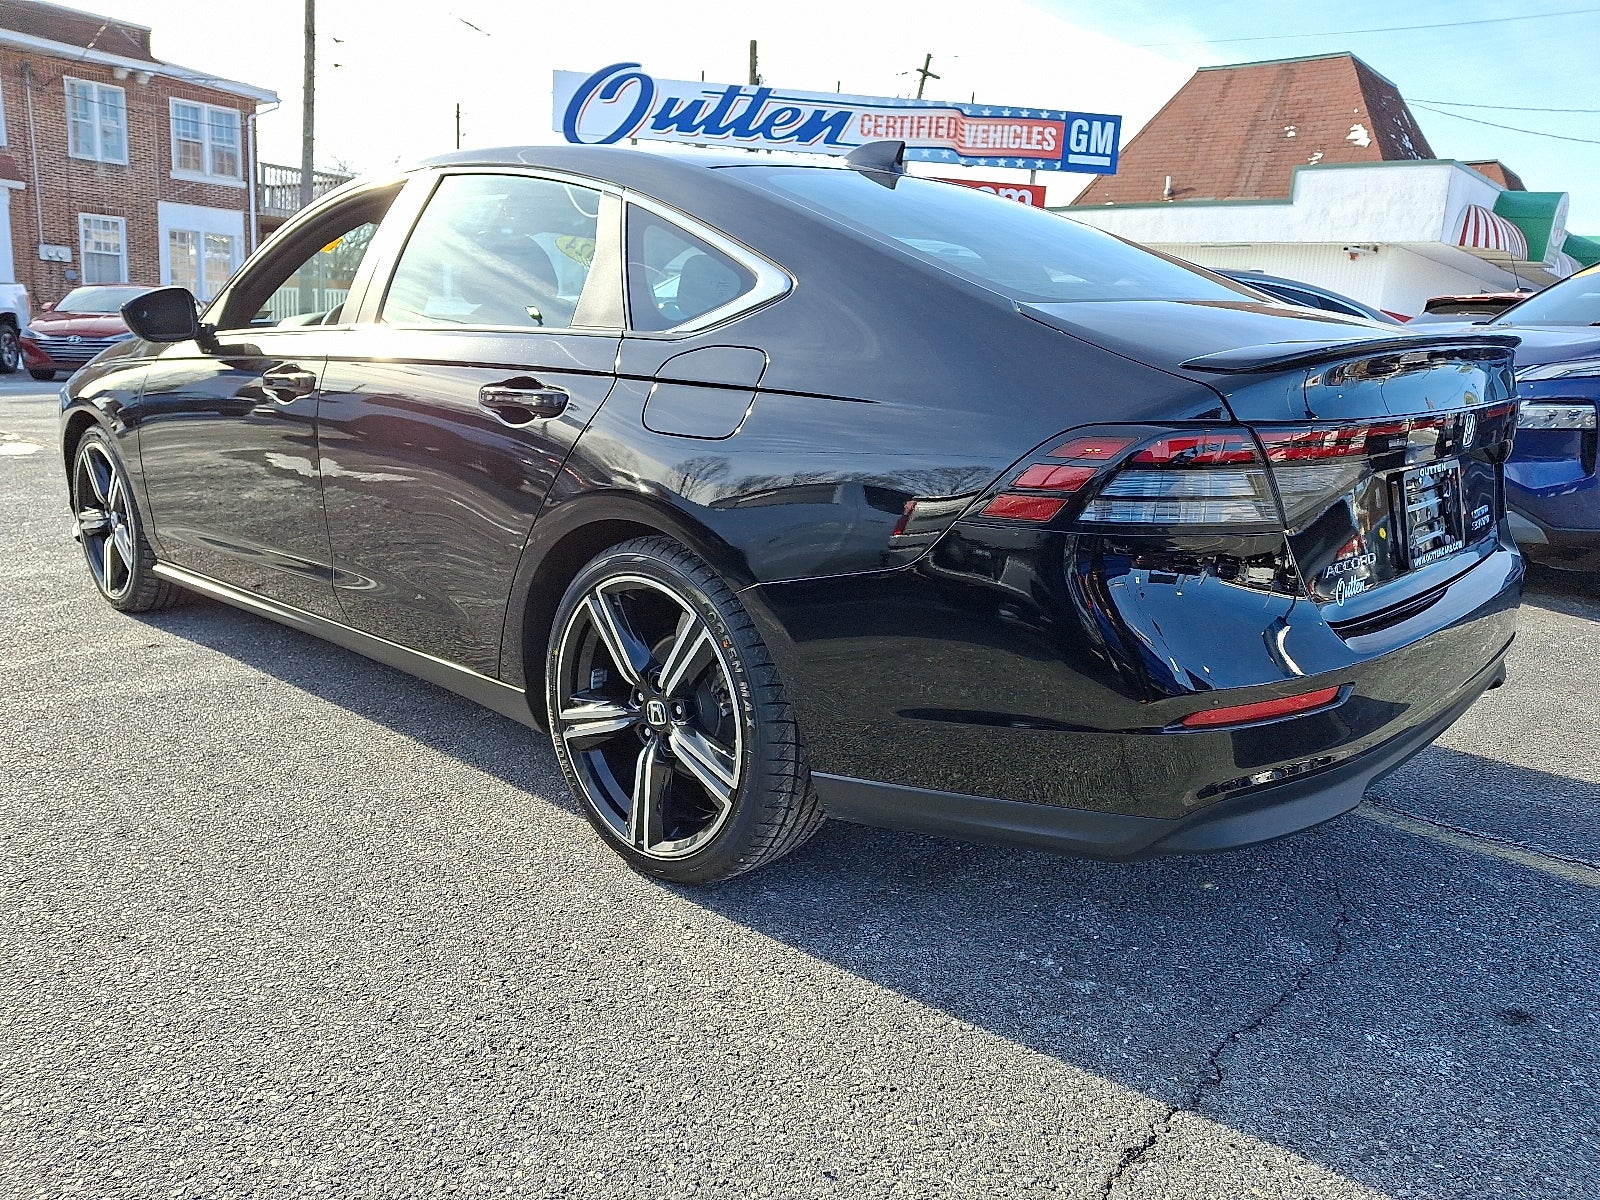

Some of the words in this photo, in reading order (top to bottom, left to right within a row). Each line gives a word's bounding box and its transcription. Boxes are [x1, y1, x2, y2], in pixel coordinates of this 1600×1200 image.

[562, 62, 854, 145] Outten
[860, 113, 959, 141] CERTIFIED
[964, 123, 1057, 152] VEHICLES
[1068, 118, 1117, 156] GM
[1321, 552, 1377, 579] ACCORD
[1335, 574, 1370, 607] Outten
